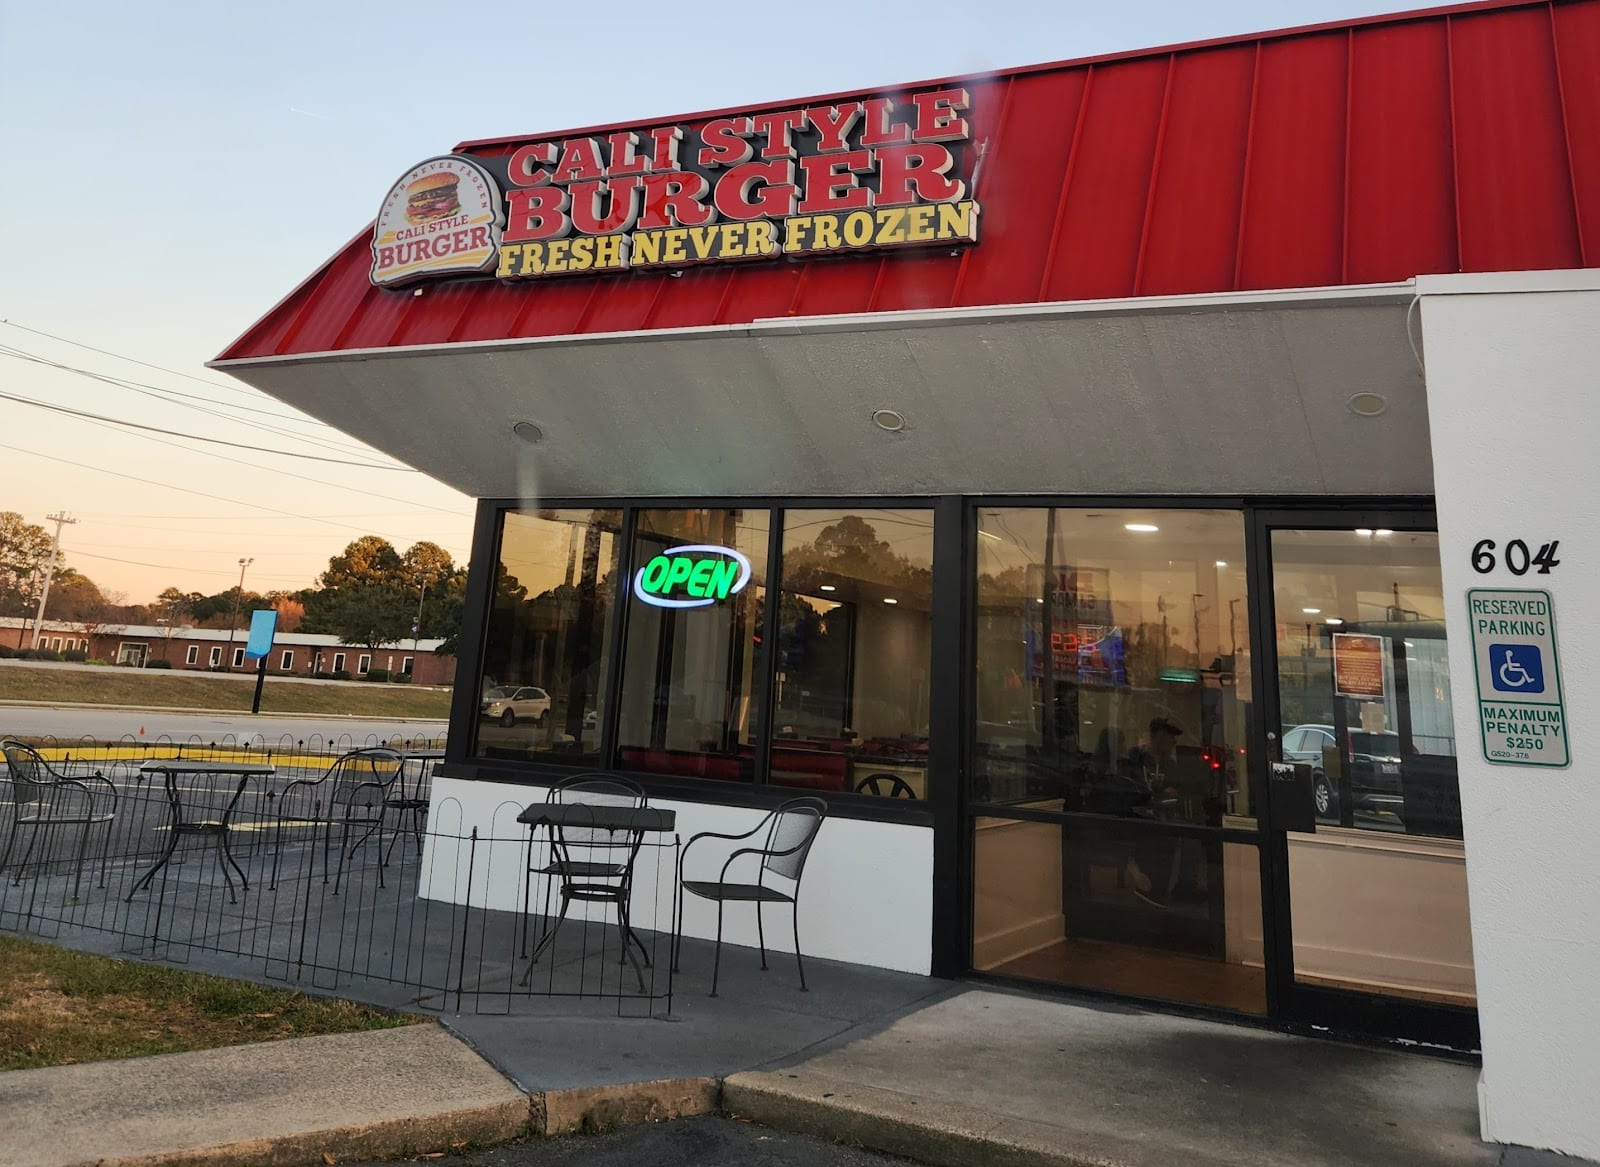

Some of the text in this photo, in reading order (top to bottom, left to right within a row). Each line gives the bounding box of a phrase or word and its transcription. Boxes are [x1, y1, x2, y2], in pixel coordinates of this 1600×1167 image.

[508, 89, 968, 186] CALI STYLE
[381, 162, 489, 227] FRESH NEVER FROZEN
[502, 143, 964, 242] BURGER
[396, 215, 469, 241] CALI STYLE
[497, 201, 974, 278] FRESH NEVER FROZEN
[378, 226, 489, 269] BURGER
[1471, 539, 1560, 576] 604
[641, 555, 738, 599] OPEN
[1472, 599, 1547, 616] RESERVED
[1478, 619, 1546, 636] PARKING
[1483, 707, 1560, 723] MAXIMUM
[1486, 722, 1560, 737] PENALTY
[1506, 737, 1544, 750] $250
